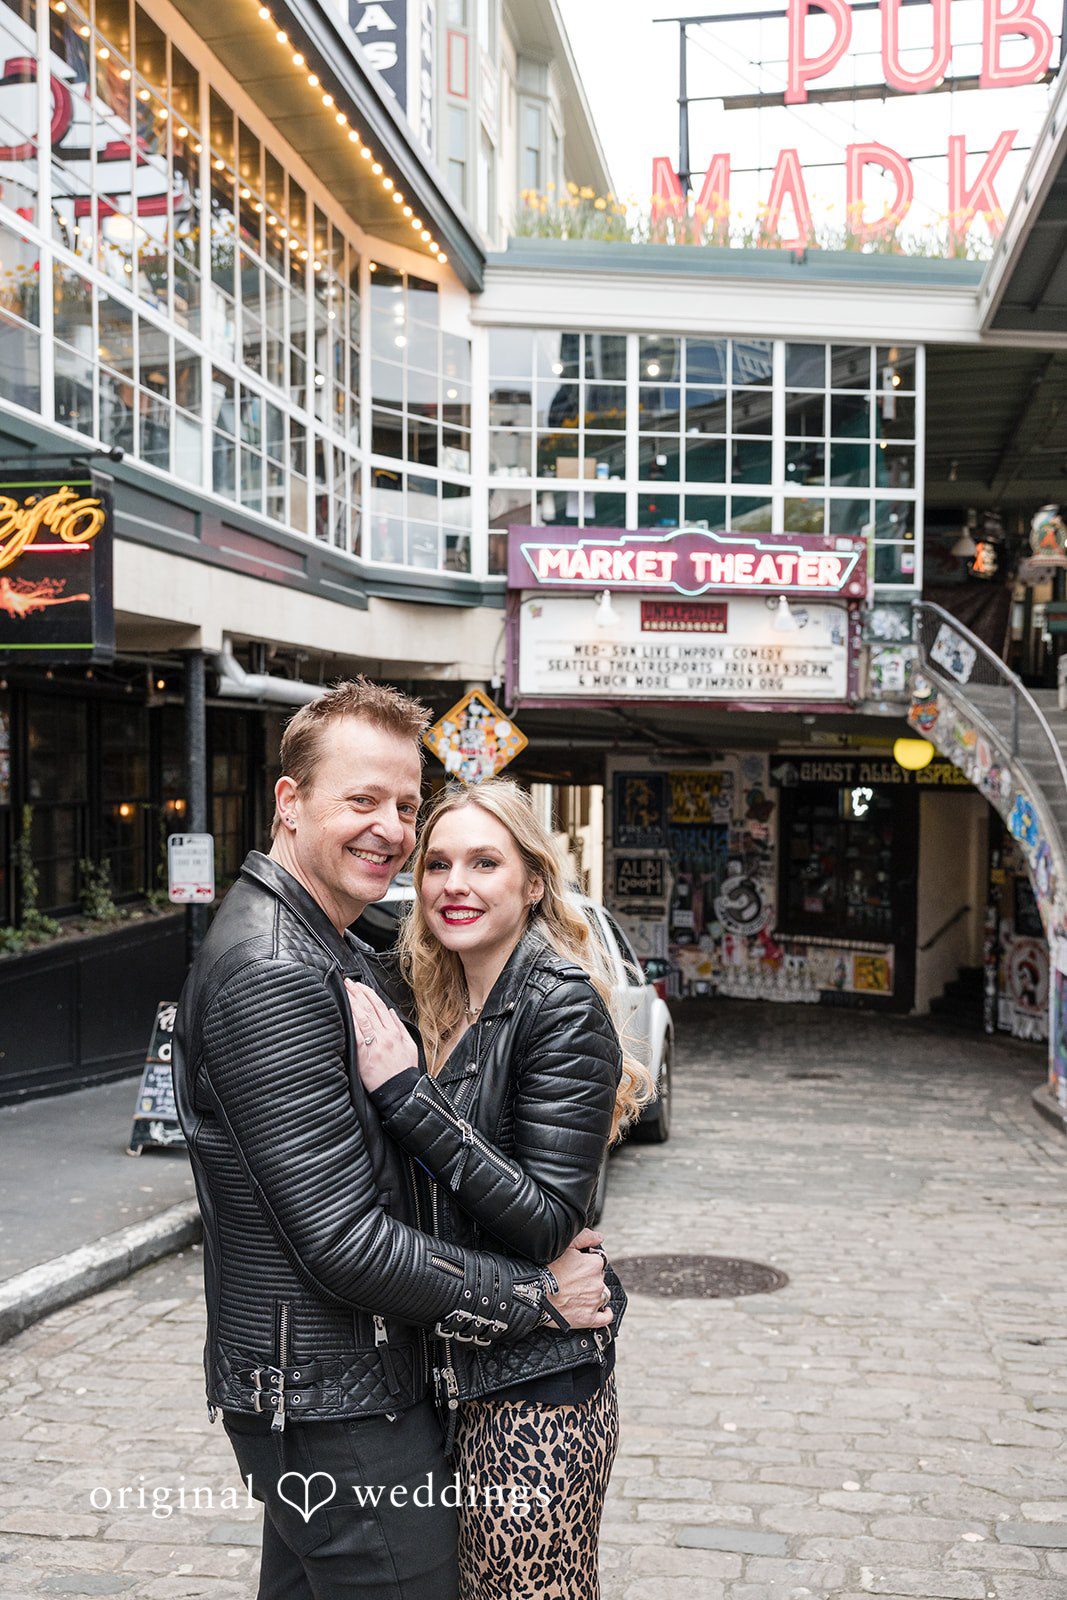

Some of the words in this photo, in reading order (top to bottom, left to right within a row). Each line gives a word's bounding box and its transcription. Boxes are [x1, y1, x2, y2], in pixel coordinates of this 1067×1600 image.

[537, 548, 678, 583] MARKET
[689, 551, 842, 586] THEATER
[612, 645, 636, 657] SUN
[643, 646, 669, 658] LIVE
[679, 647, 723, 659] IMPROV
[733, 648, 782, 660] COMEDY
[548, 660, 600, 672] SEATTLE
[610, 660, 713, 674] THEATRESPORTS
[593, 676, 627, 688] MUCH
[636, 677, 669, 689] MORE
[801, 762, 855, 782] GHOST
[859, 763, 912, 784] ALLEY
[620, 860, 662, 878] ALIBI
